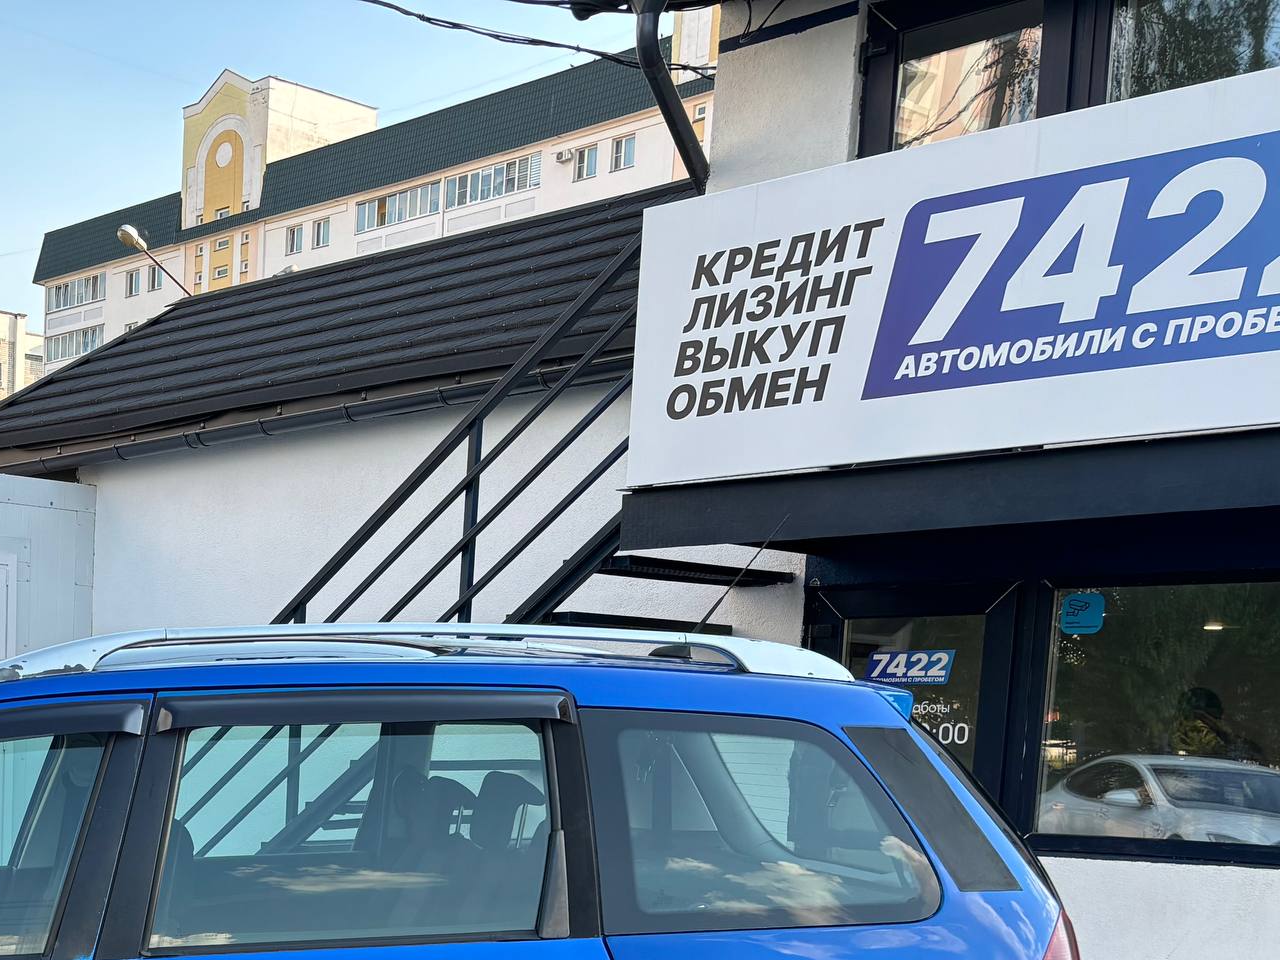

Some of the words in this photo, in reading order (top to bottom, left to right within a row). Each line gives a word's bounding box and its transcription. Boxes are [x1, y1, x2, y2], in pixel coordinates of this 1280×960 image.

[692, 218, 885, 290] КРЕДИТ
[908, 157, 1280, 345] 742
[683, 266, 873, 333] ЛИЗИНГ
[674, 315, 846, 377] ВЫКУП
[894, 326, 1126, 380] АВТОМОБИЛИ
[1132, 323, 1157, 348] С
[667, 364, 831, 420] ОБМЕН
[870, 652, 949, 677] 7422
[912, 701, 950, 714] аботы
